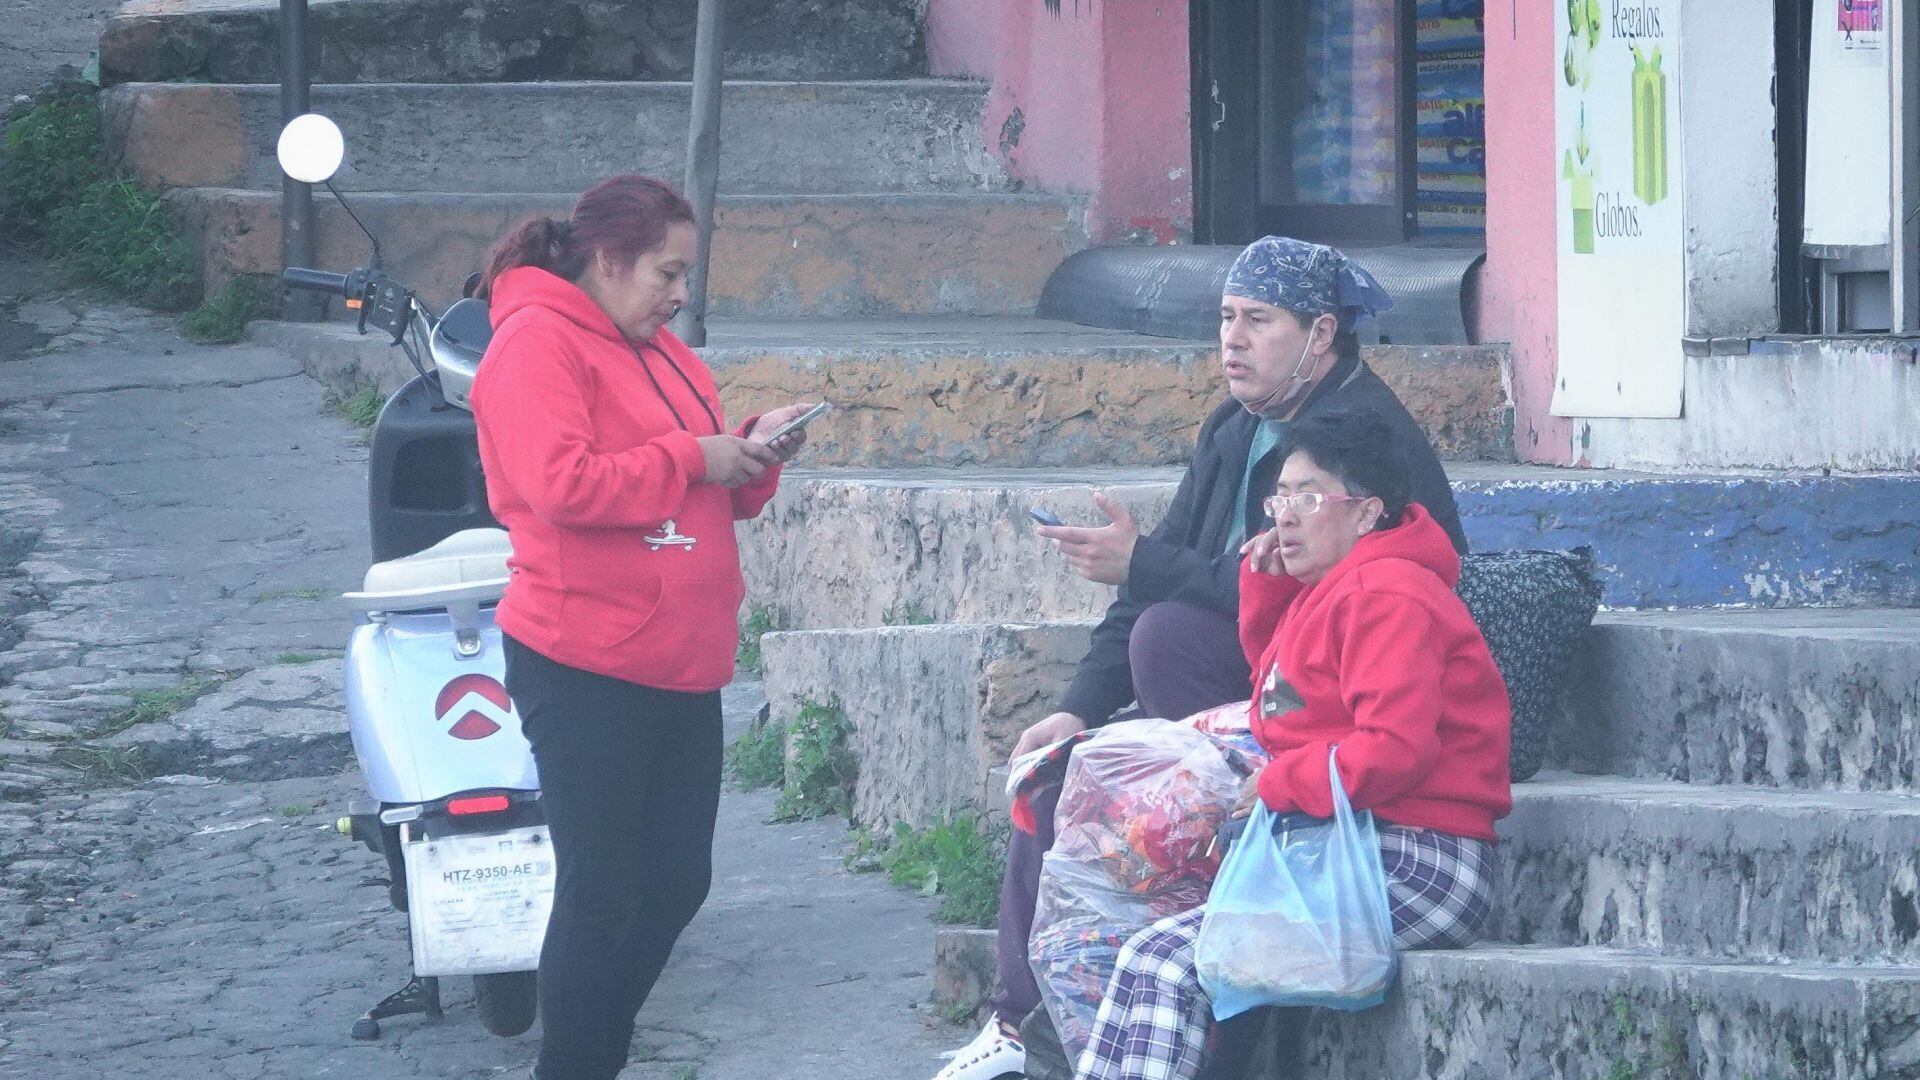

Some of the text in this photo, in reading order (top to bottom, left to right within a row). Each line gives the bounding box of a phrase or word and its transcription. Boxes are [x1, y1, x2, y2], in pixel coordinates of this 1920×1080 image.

[1611, 0, 1664, 51] Regalos.
[1595, 191, 1642, 238] Globos.
[443, 862, 532, 883] HTZ-9350-AE
